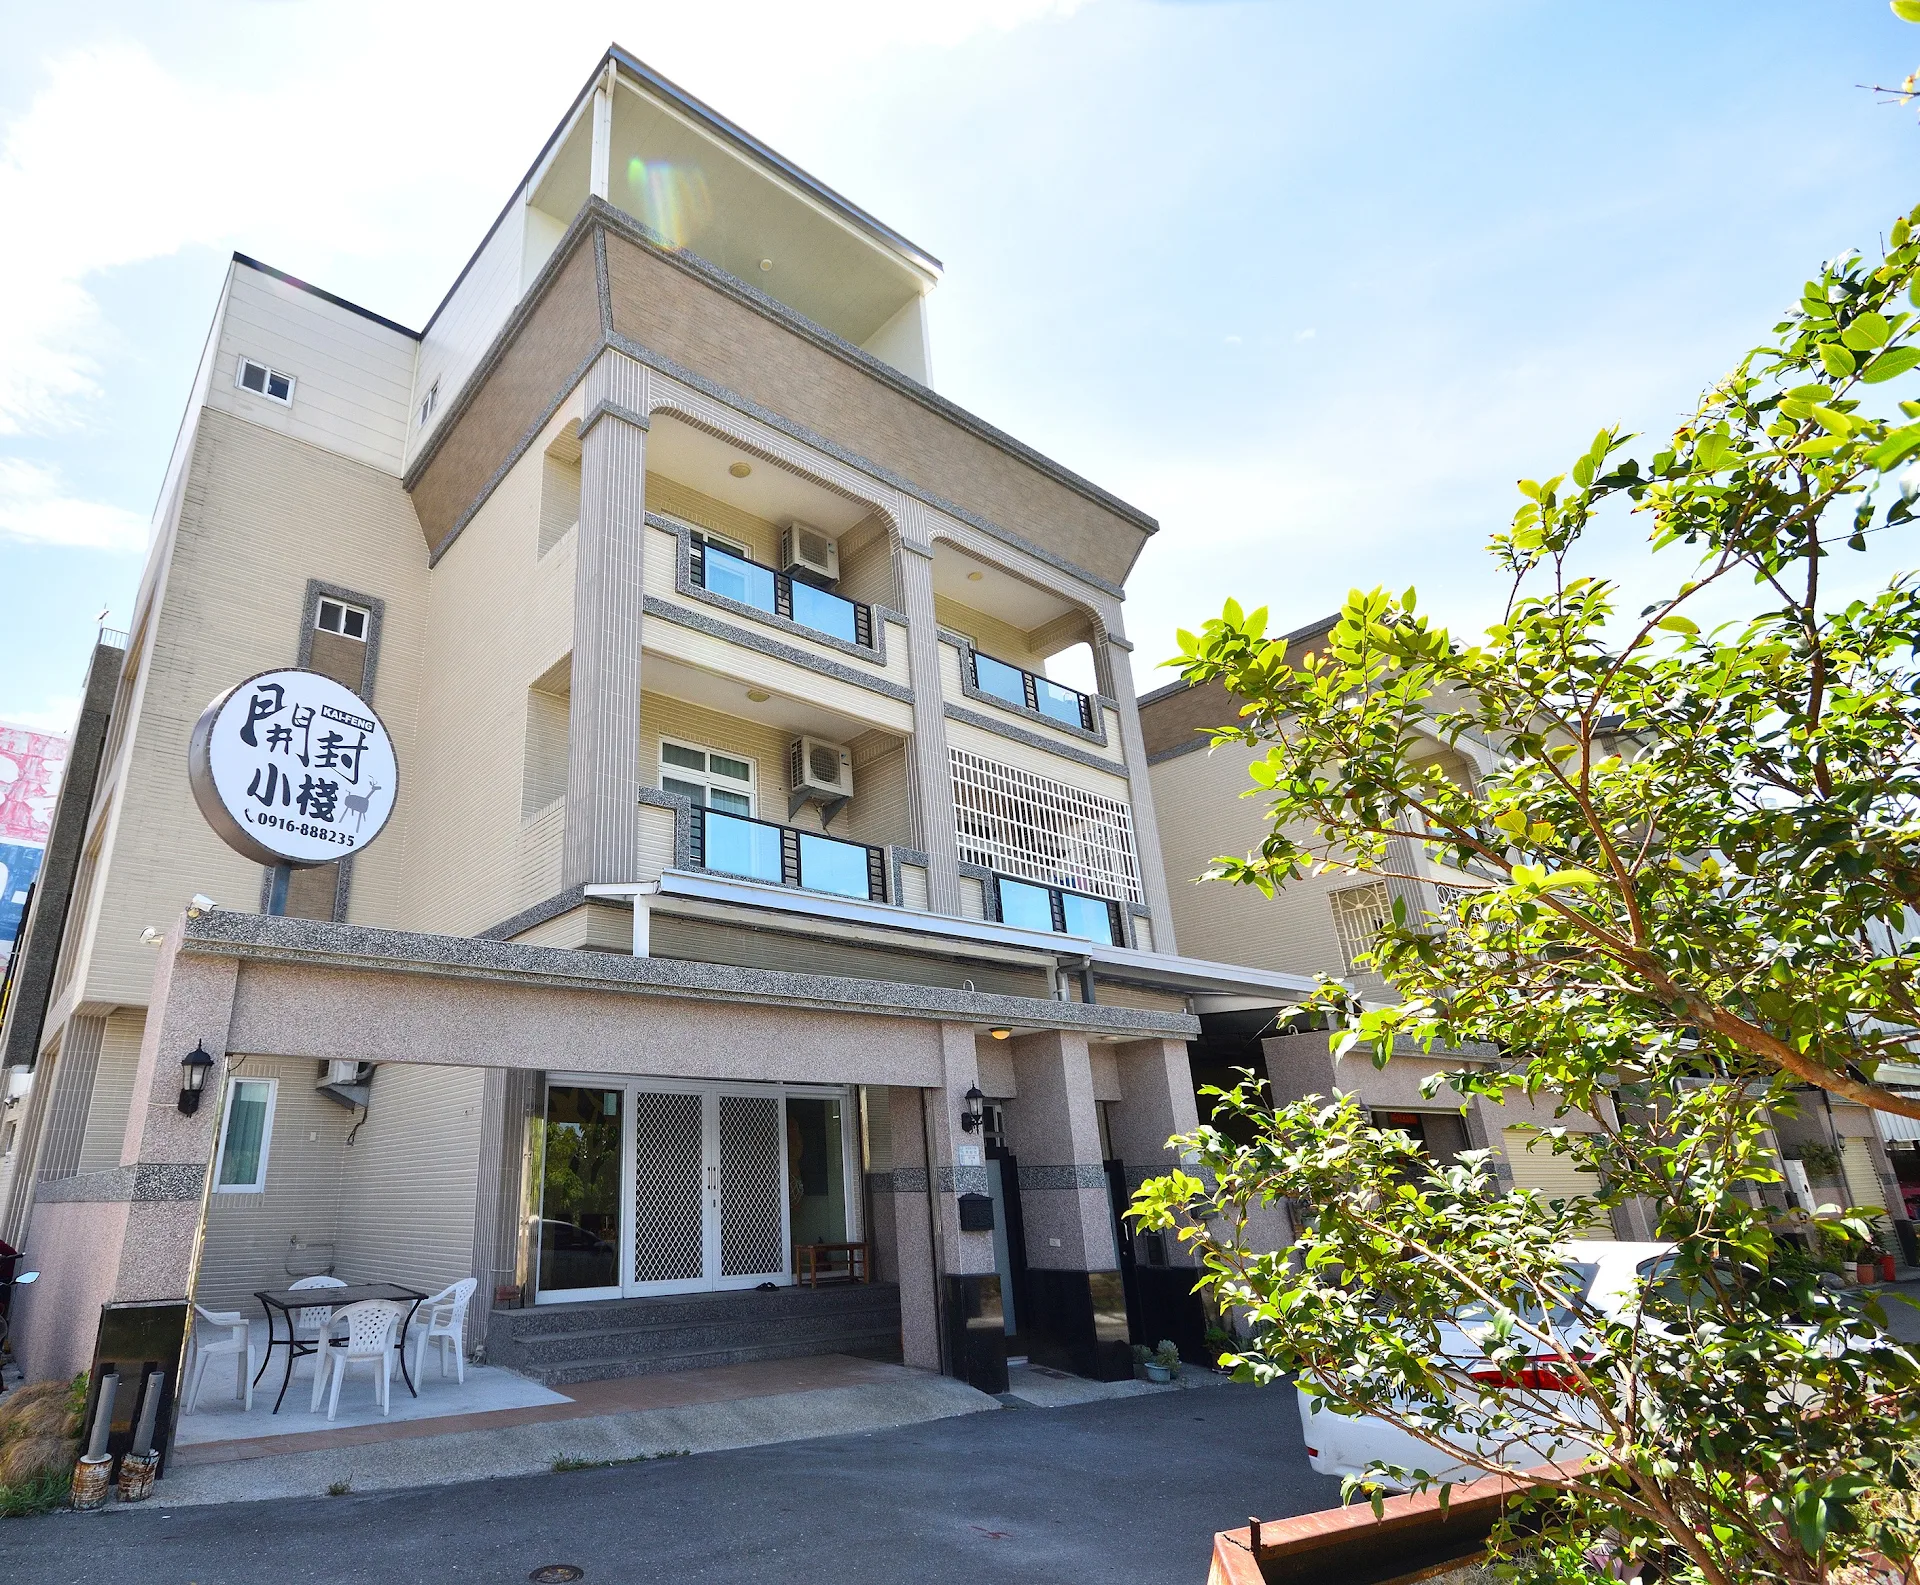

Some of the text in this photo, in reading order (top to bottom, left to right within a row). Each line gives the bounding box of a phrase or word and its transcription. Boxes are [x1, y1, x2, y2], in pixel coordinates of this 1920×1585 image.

[239, 682, 369, 785] 開封
[322, 705, 374, 732] KAI-FENG
[246, 762, 339, 822] 小棧
[257, 812, 355, 847] 0916-888235
